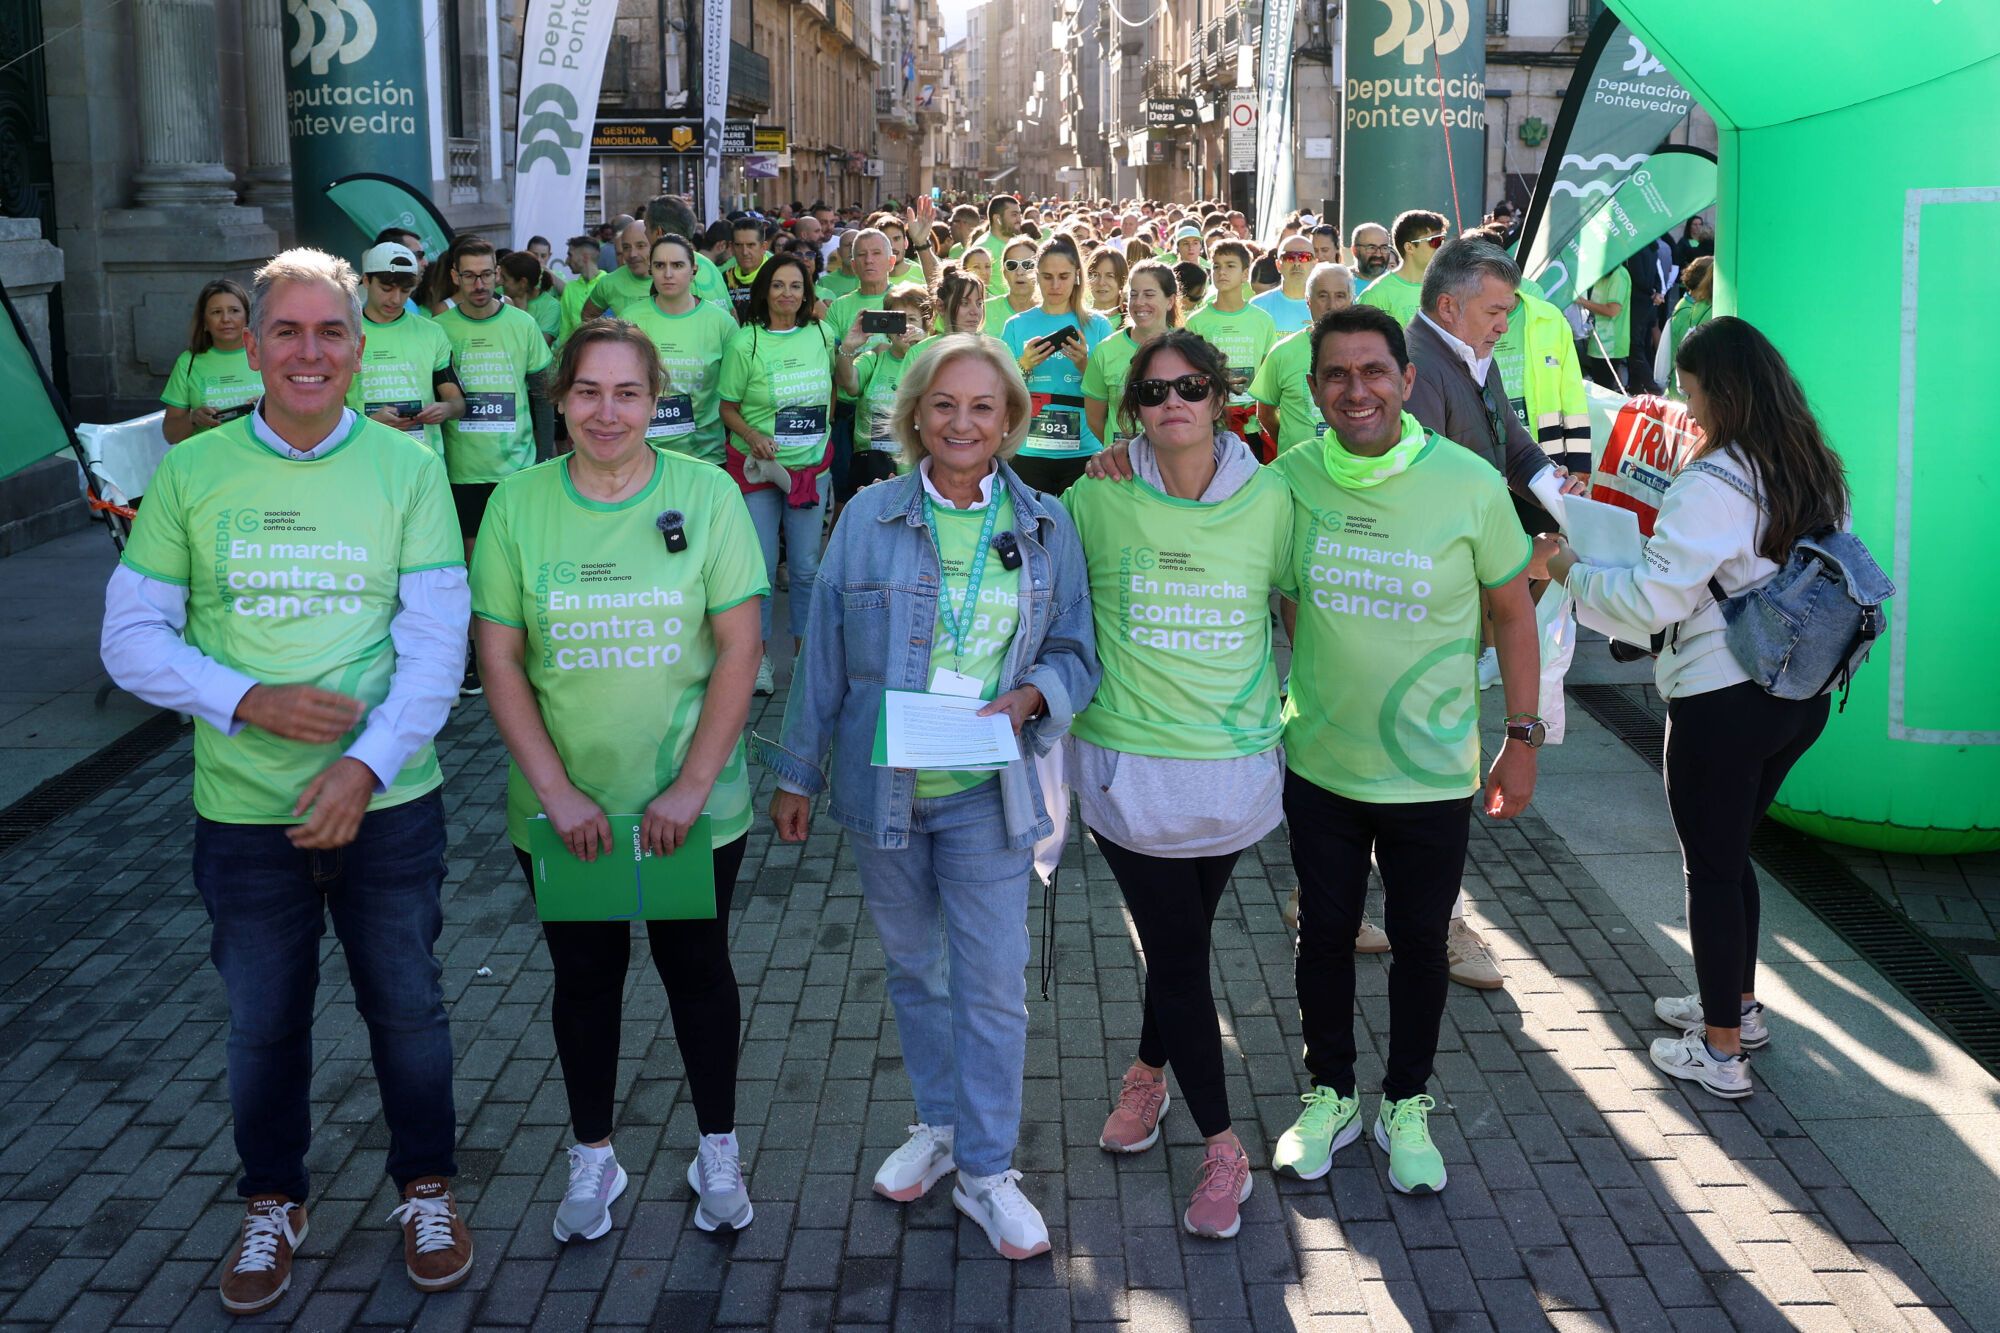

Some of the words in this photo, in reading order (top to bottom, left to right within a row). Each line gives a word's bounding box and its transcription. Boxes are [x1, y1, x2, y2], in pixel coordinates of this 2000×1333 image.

[288, 79, 413, 115] eputación
[1348, 73, 1485, 106] Deputación
[1597, 79, 1690, 100] Deputación
[1149, 102, 1175, 112] Viajes
[1595, 92, 1687, 115] Pontevedra
[289, 110, 415, 136] ontevedra
[1149, 112, 1175, 121] Deza
[603, 126, 646, 135] GESTION
[775, 381, 818, 396] contra
[472, 404, 503, 416] 2488
[789, 419, 816, 430] 2274
[1040, 422, 1068, 434] 1923
[1345, 522, 1372, 530] española
[1347, 515, 1377, 524] asociación
[1344, 528, 1363, 536] contra
[1368, 531, 1389, 539] cancro
[215, 508, 234, 613] PONTEVEDRA
[230, 539, 262, 559] En
[269, 541, 368, 562] marcha
[1315, 536, 1342, 557] En
[1346, 544, 1433, 570] marcha
[1643, 545, 1671, 567] nfocáncer
[228, 566, 336, 590] contra
[345, 573, 366, 592] o
[1131, 575, 1158, 594] En
[1165, 580, 1247, 599] marcha
[1310, 564, 1403, 595] contra
[1412, 580, 1431, 599] o
[550, 591, 580, 610] En
[588, 586, 683, 609] marcha
[1119, 546, 1132, 642] PONTEVEDRA
[1314, 588, 1428, 623] cancro
[234, 595, 362, 618] cancro
[535, 562, 555, 668] PONTEVEDRA
[1129, 603, 1222, 625] contra
[1230, 609, 1246, 626] o
[550, 615, 655, 640] contra
[663, 617, 682, 636] o
[997, 617, 1012, 634] o
[1130, 626, 1244, 650] cancro
[556, 643, 682, 670] cancro
[633, 833, 641, 861] cancro
[416, 1183, 441, 1191] PRADA
